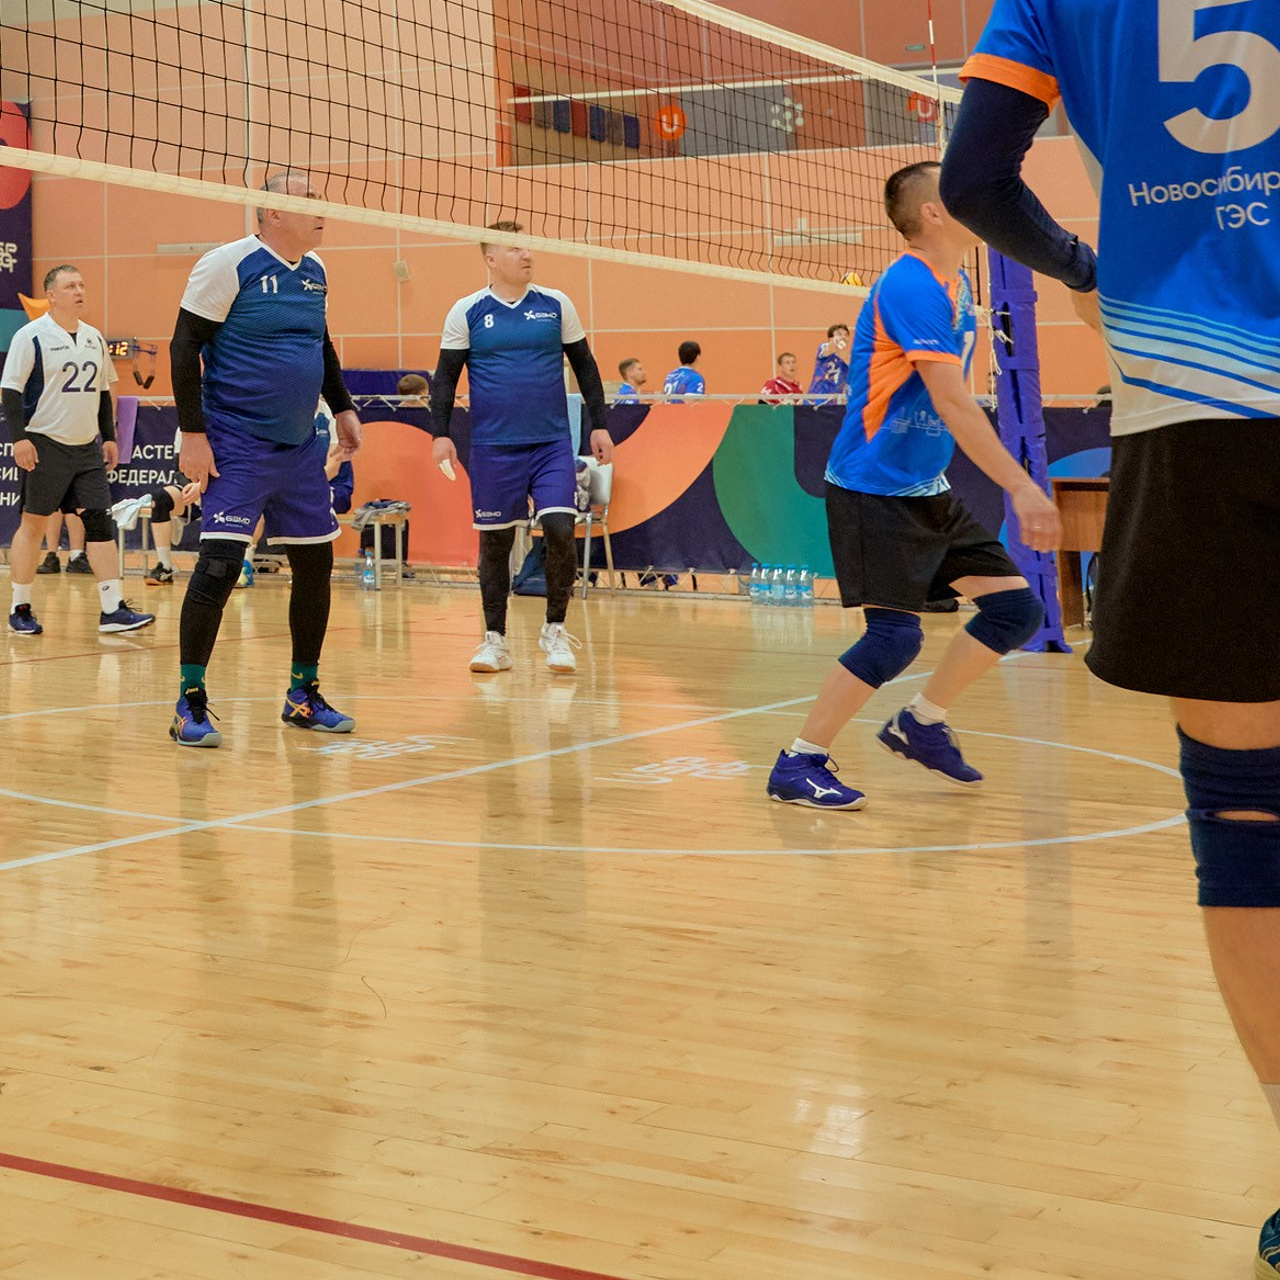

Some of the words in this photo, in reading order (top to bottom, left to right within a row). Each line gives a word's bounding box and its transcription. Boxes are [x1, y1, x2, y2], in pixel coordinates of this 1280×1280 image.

[1215, 202, 1271, 231] ГЭС
[260, 275, 278, 293] 11
[484, 314, 494, 328] 8
[61, 361, 98, 393] 22
[132, 444, 174, 460] АСТЕ
[106, 469, 178, 487] ФЕДЕРАЛ
